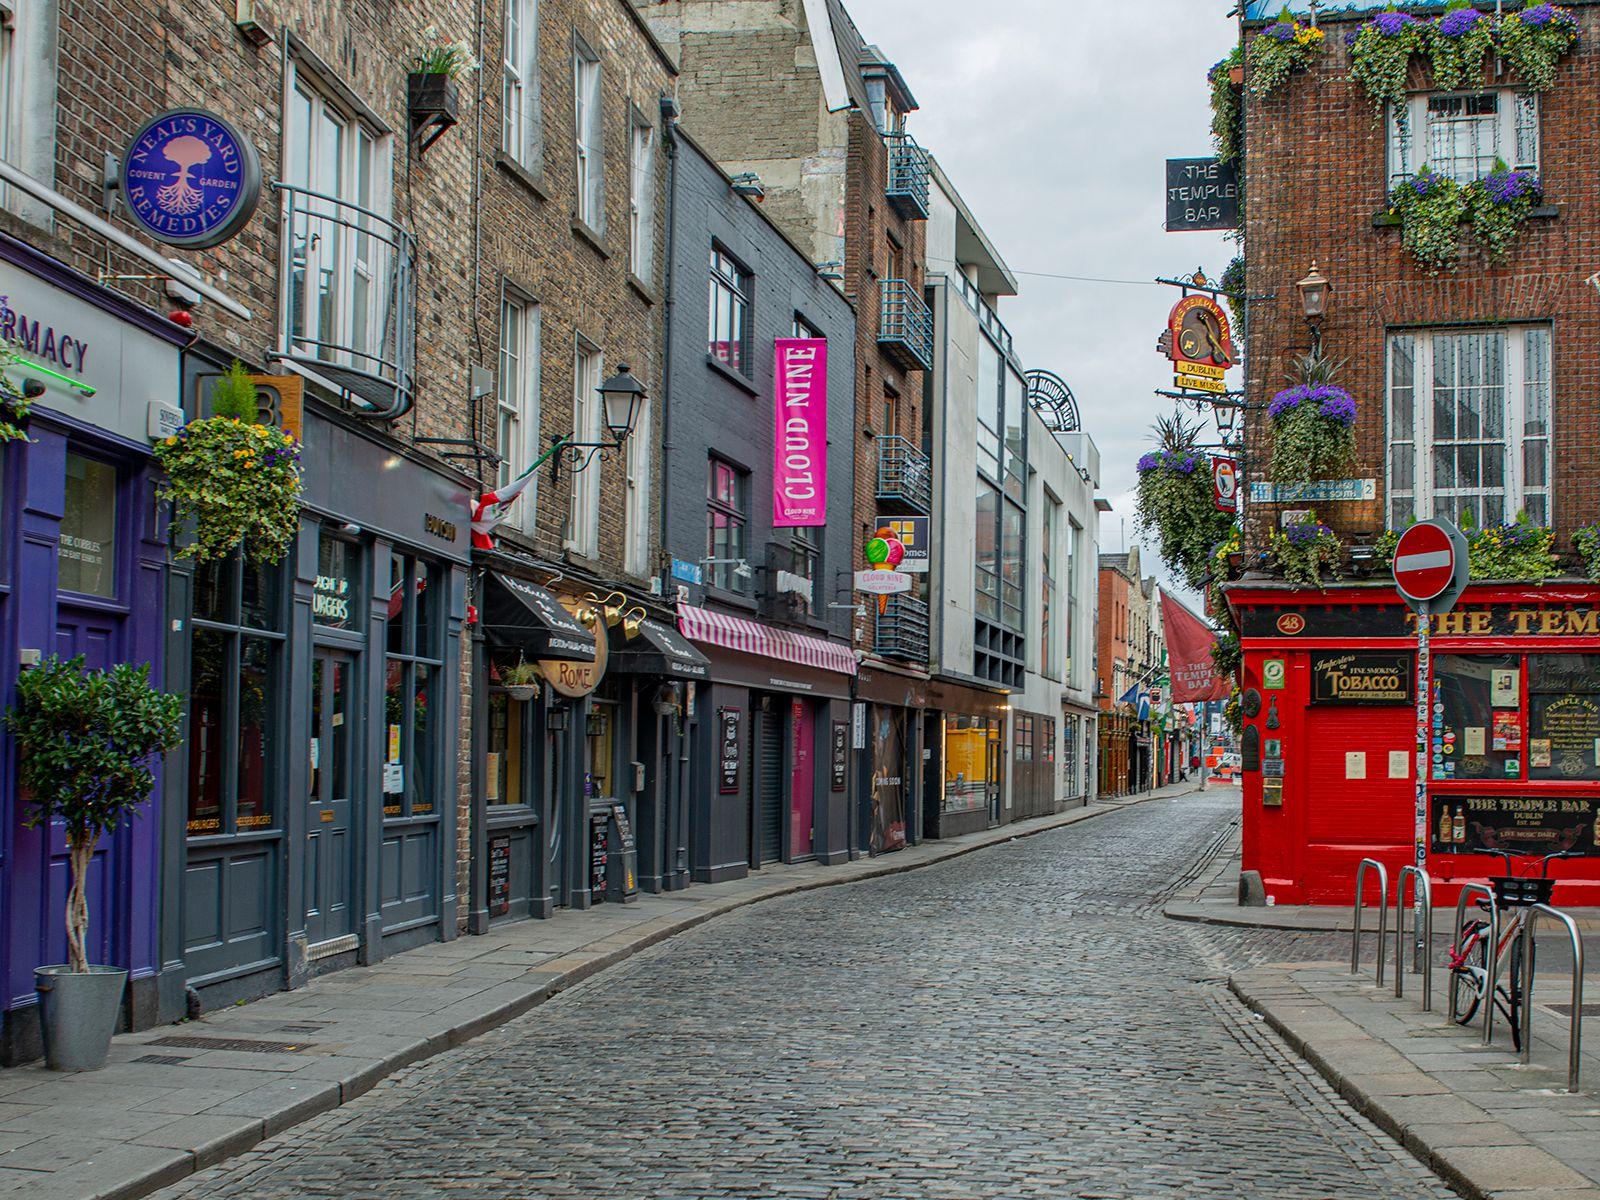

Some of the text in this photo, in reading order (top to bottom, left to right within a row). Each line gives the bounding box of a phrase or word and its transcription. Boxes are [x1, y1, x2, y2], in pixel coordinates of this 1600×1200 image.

[132, 118, 239, 174] NEAL'S YARD
[1185, 165, 1218, 179] THE
[129, 169, 237, 190] COVENT GARDEN
[1169, 183, 1235, 201] TEMPLE
[131, 185, 231, 232] REMEDIES
[1185, 206, 1220, 222] BAR
[1174, 298, 1229, 341] THE TEMPLE BAR
[1187, 364, 1217, 375] DUBLIN
[786, 347, 816, 407] NINE
[1181, 379, 1222, 391] LIVE MUSIC
[785, 417, 815, 500] CLOUD
[1365, 484, 1373, 495] 2
[784, 508, 816, 516] CLOUD NINE
[863, 573, 904, 583] CLOUD NINE
[312, 593, 348, 620] URGERS
[1280, 617, 1299, 629] 48
[1405, 610, 1494, 635] THE
[1187, 663, 1207, 671] THE
[1313, 654, 1356, 672] Importers
[560, 662, 593, 690] ROME
[1367, 667, 1399, 675] SMOKING
[1187, 679, 1211, 690] BAR
[1325, 670, 1400, 697] TOBACCO
[1340, 691, 1369, 699] Always
[1383, 690, 1407, 699] Stock
[1545, 697, 1599, 713] TEMPLE BAR
[889, 777, 900, 785] SOON
[1467, 799, 1591, 813] THE TEMPLE BAR
[1514, 812, 1543, 820] DUBLIN
[1500, 830, 1516, 838] LIVE
